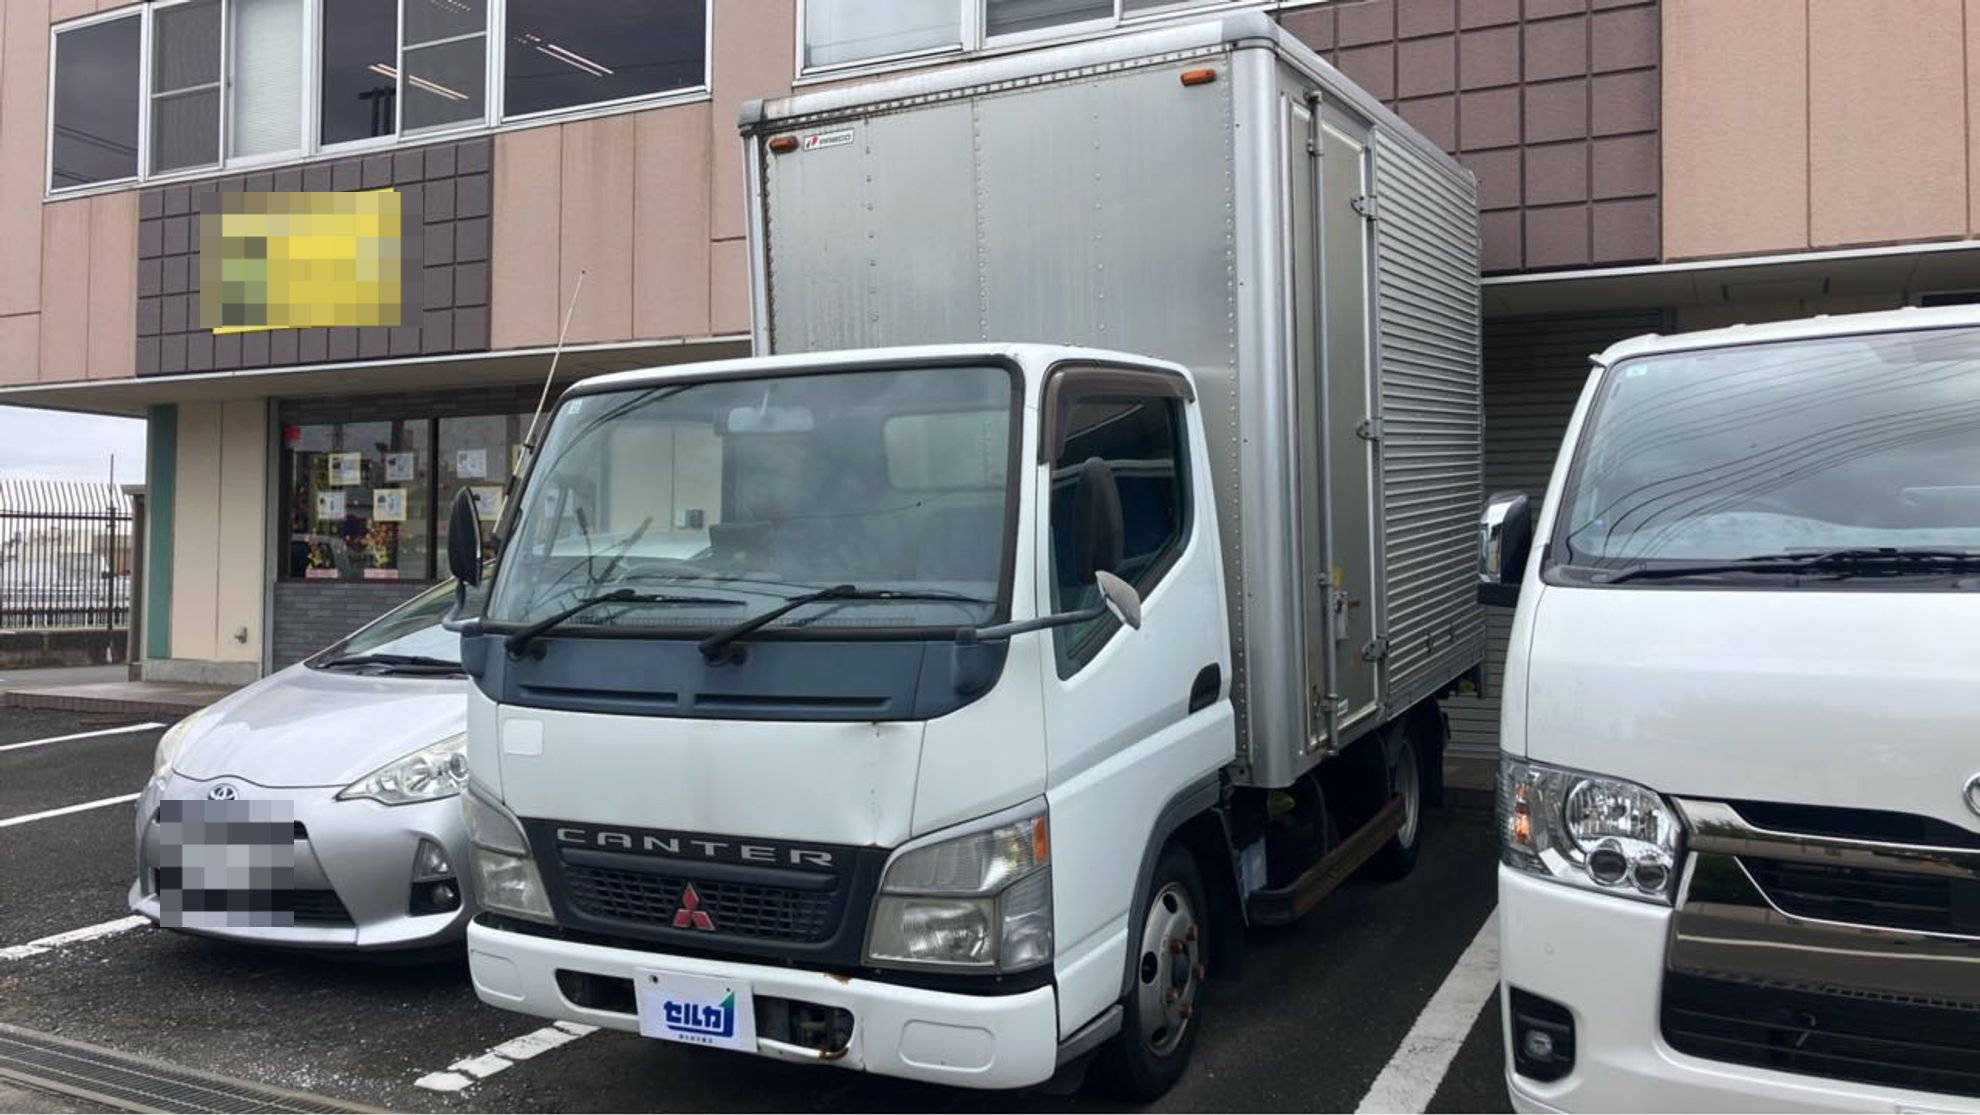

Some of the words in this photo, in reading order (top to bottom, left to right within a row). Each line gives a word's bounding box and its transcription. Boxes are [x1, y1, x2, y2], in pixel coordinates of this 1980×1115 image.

[557, 828, 833, 866] CANTER
[664, 1000, 723, 1029] セルカ
